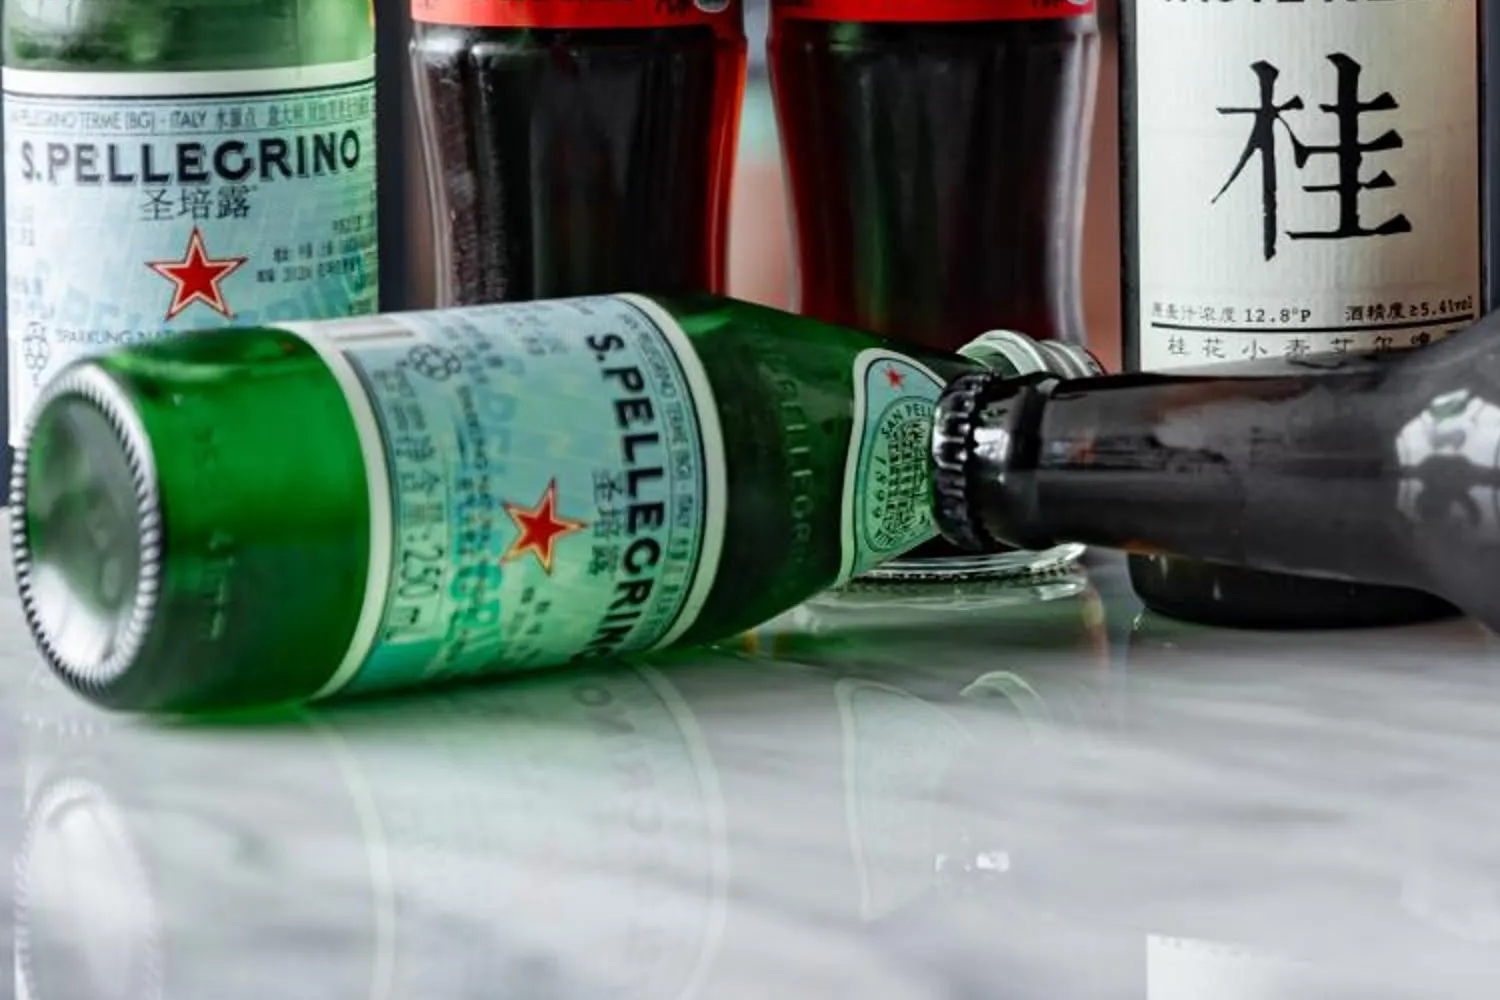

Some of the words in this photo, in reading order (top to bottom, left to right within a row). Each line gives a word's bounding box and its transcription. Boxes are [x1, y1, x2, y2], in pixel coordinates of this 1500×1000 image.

[22, 128, 360, 184] S.PELLEGRINO
[1211, 52, 1412, 261] 桂
[140, 188, 250, 222] 圣培露
